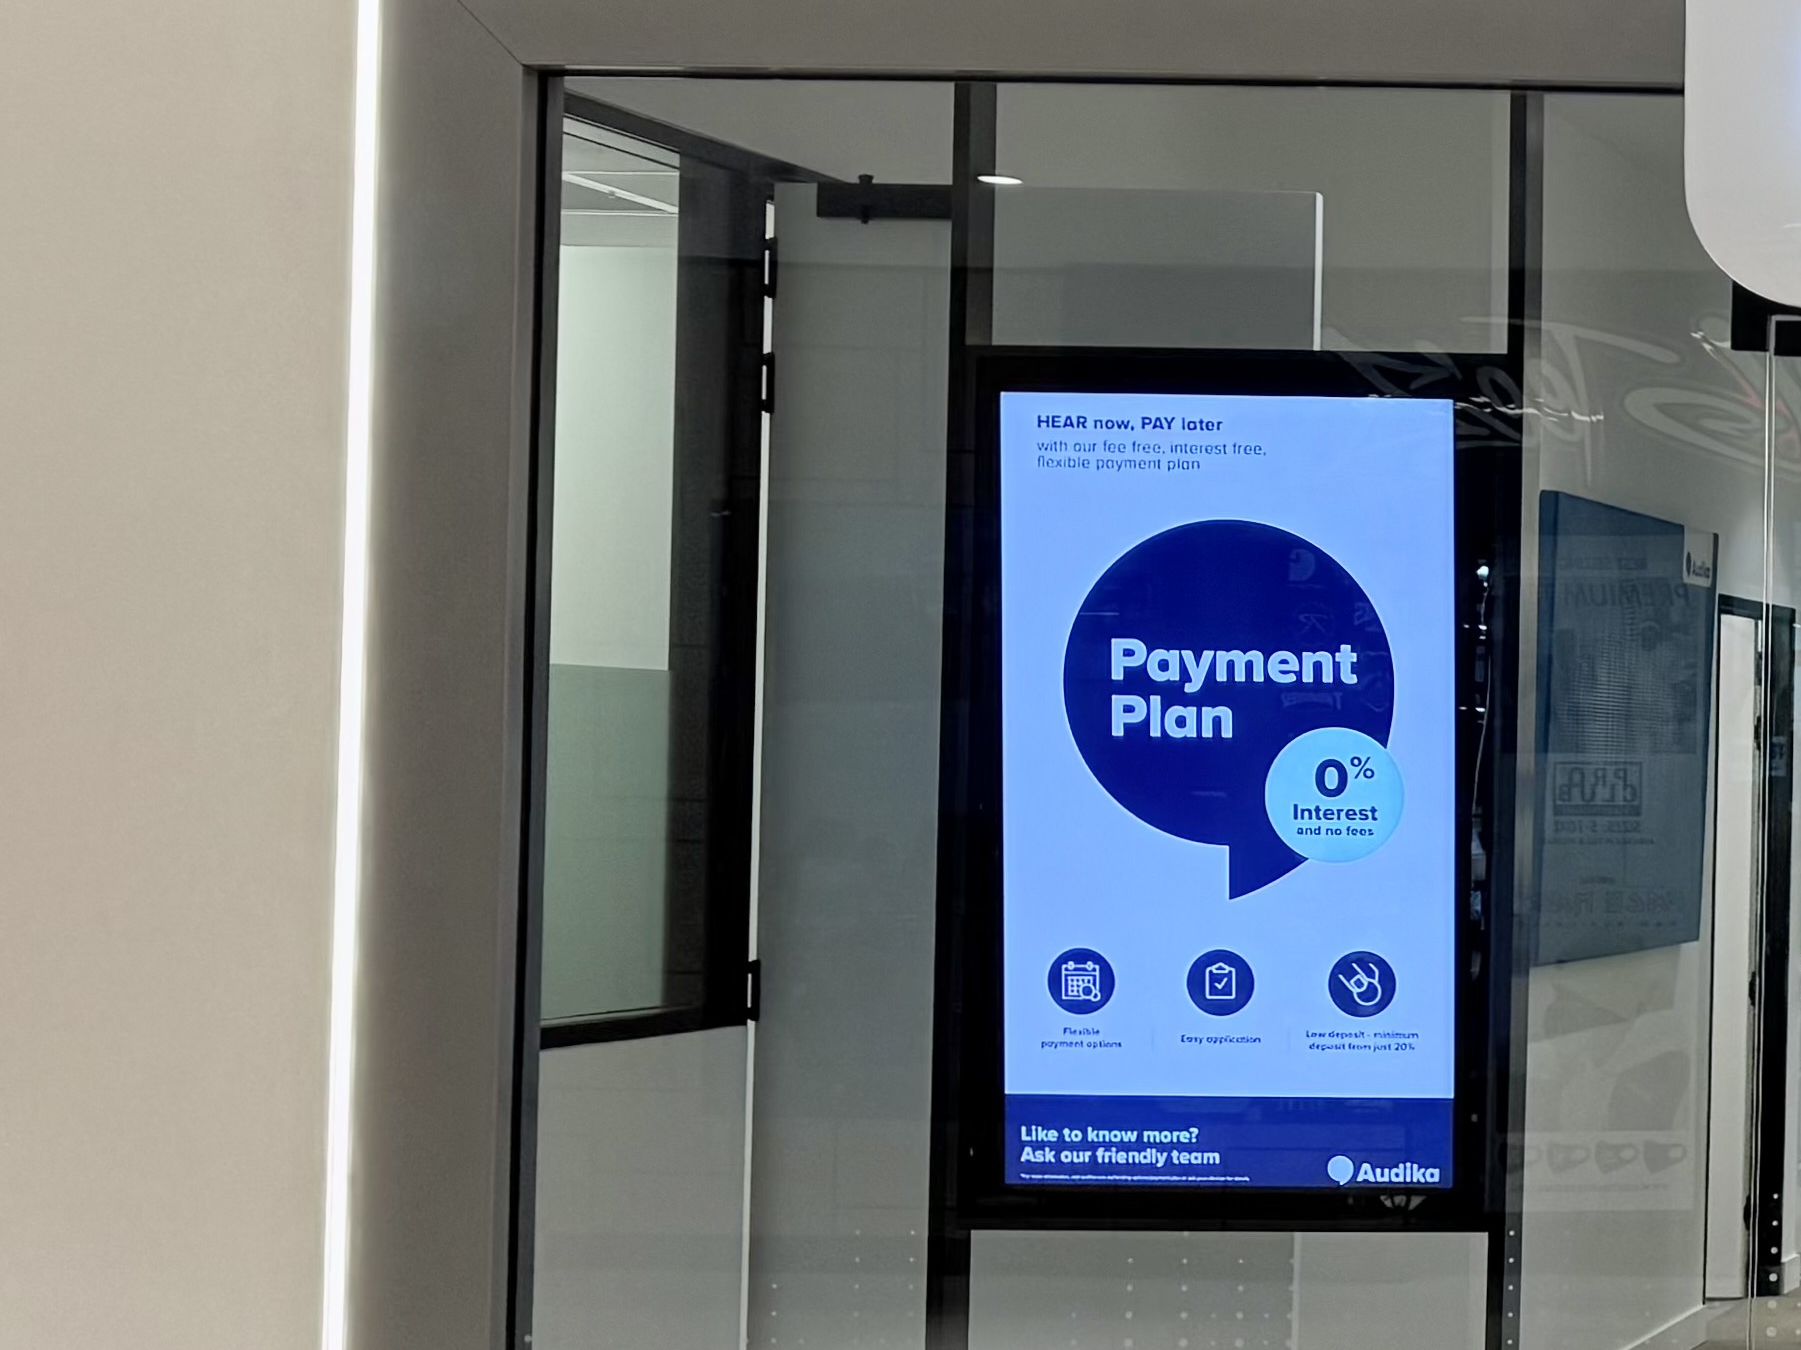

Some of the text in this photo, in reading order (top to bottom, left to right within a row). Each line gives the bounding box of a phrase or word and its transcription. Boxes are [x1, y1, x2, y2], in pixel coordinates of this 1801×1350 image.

[1037, 415, 1223, 432] HEAR now, PAY later
[1037, 440, 1267, 457] with our fee free, interest free,
[1037, 456, 1200, 472] flexible payment plan
[1110, 637, 1358, 693] Payment
[1111, 694, 1233, 739] Plan
[1315, 756, 1375, 798] 0%
[1293, 803, 1378, 821] Interest
[1296, 827, 1374, 836] and no fees
[1040, 1039, 1122, 1049] payment options
[1020, 1125, 1199, 1143] Like to know more?
[1020, 1147, 1220, 1167] Ask our friendly team
[1356, 1162, 1441, 1183] Audika
